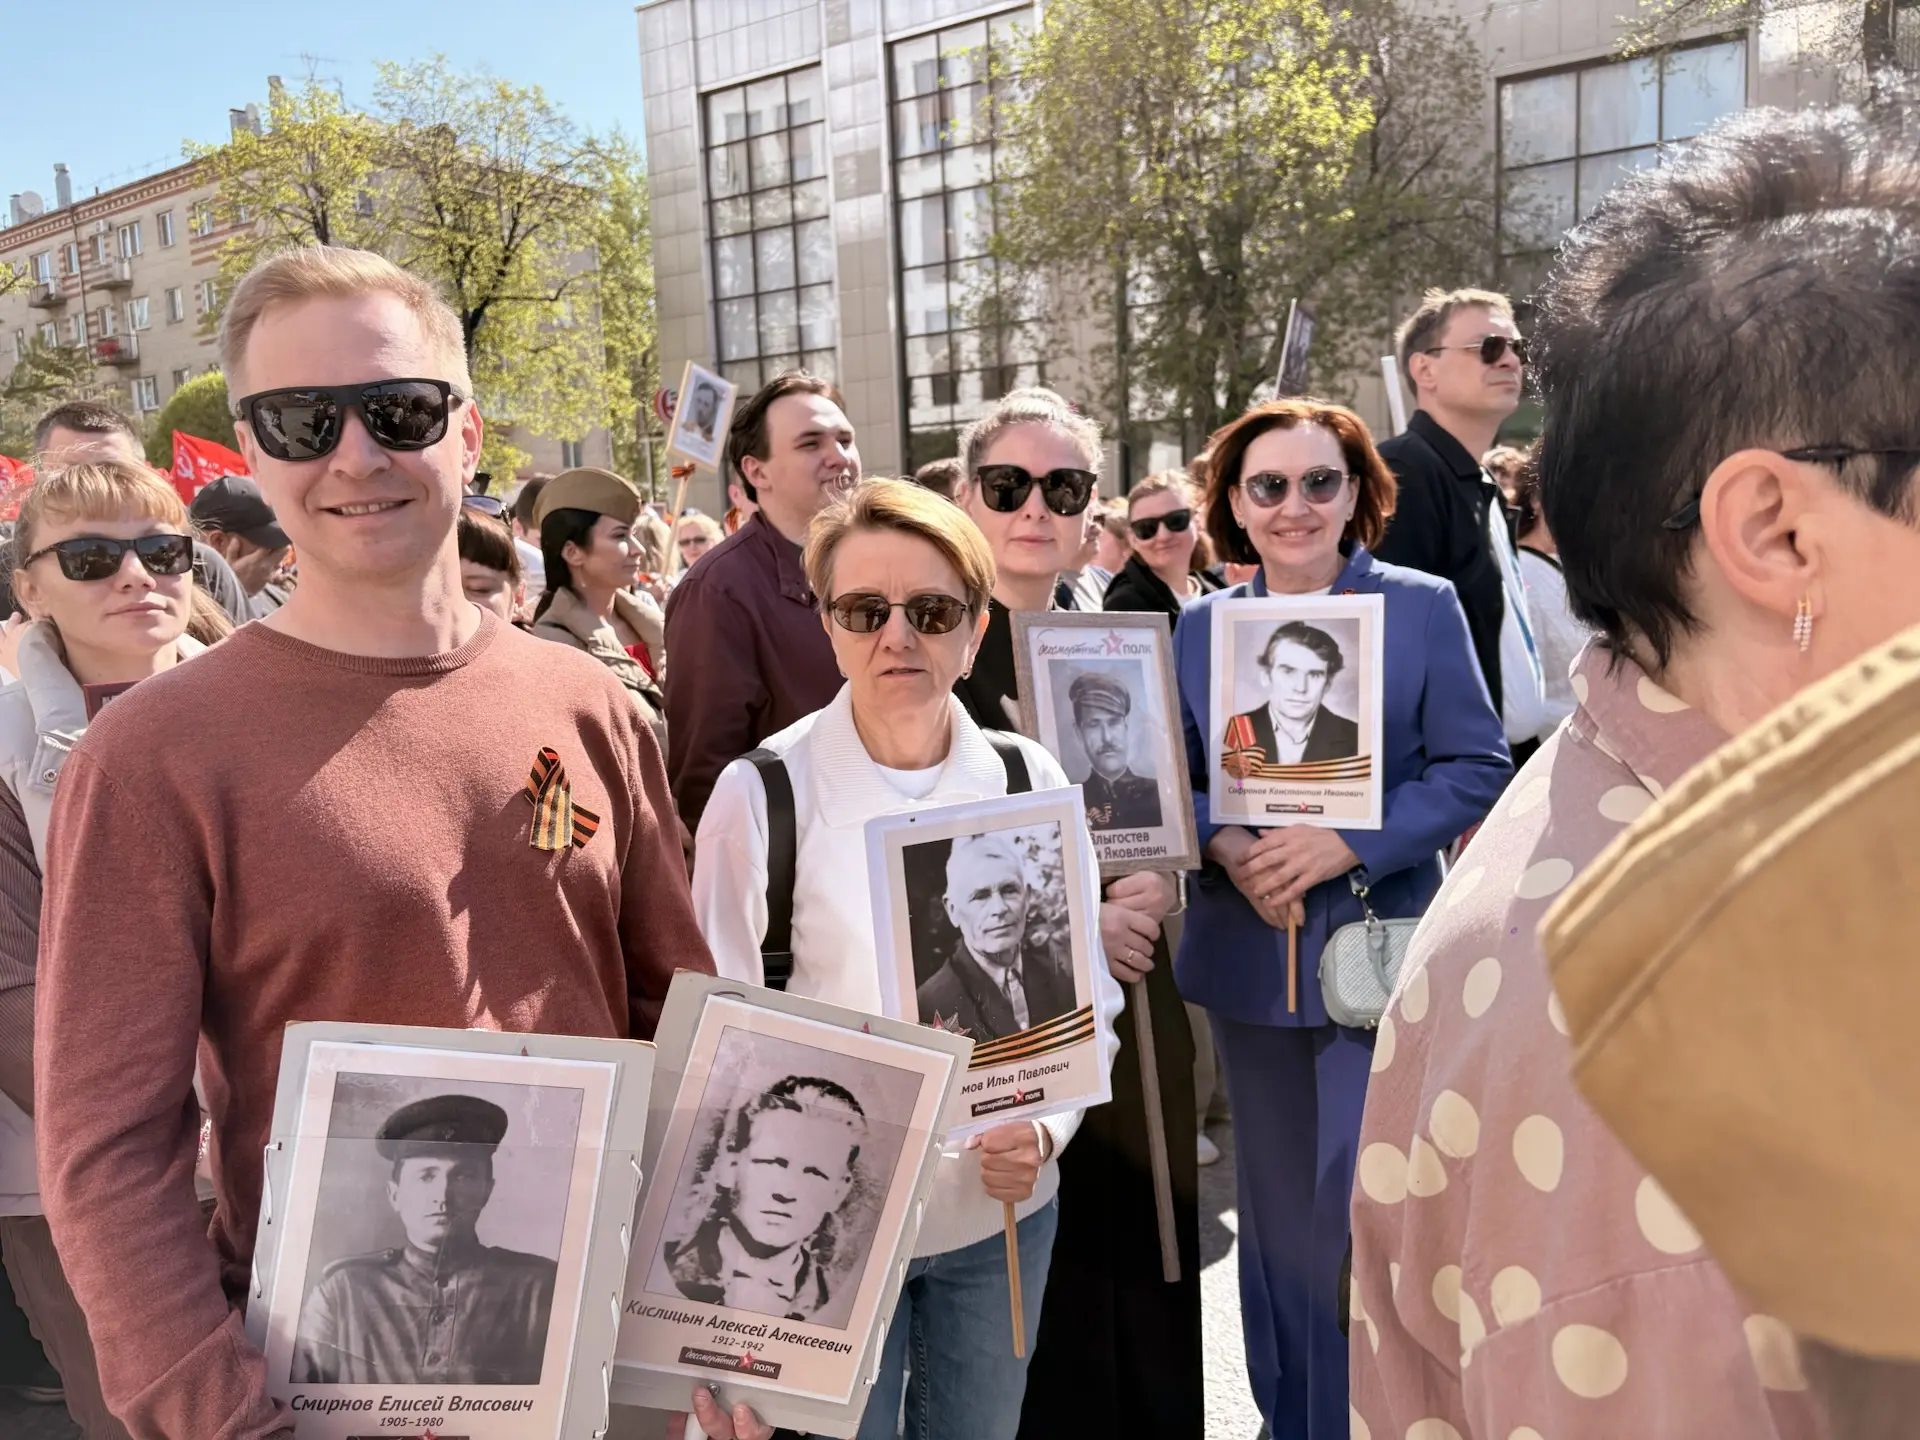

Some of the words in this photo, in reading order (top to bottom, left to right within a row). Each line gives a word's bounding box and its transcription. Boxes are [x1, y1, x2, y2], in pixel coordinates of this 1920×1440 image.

[1269, 787, 1322, 796] Константин
[1324, 788, 1364, 797] Иванович
[1104, 845, 1167, 859] Яковлевич
[960, 1081, 984, 1095] мов
[986, 1072, 1015, 1089] Илья
[1018, 1061, 1070, 1082] Павлович
[625, 1299, 705, 1326] Кислицын
[706, 1314, 768, 1338] Алексей
[769, 1329, 853, 1355] Алексеевич
[290, 1394, 374, 1415] Смирнов
[378, 1395, 444, 1412] Елисей
[448, 1396, 534, 1413] Власович
